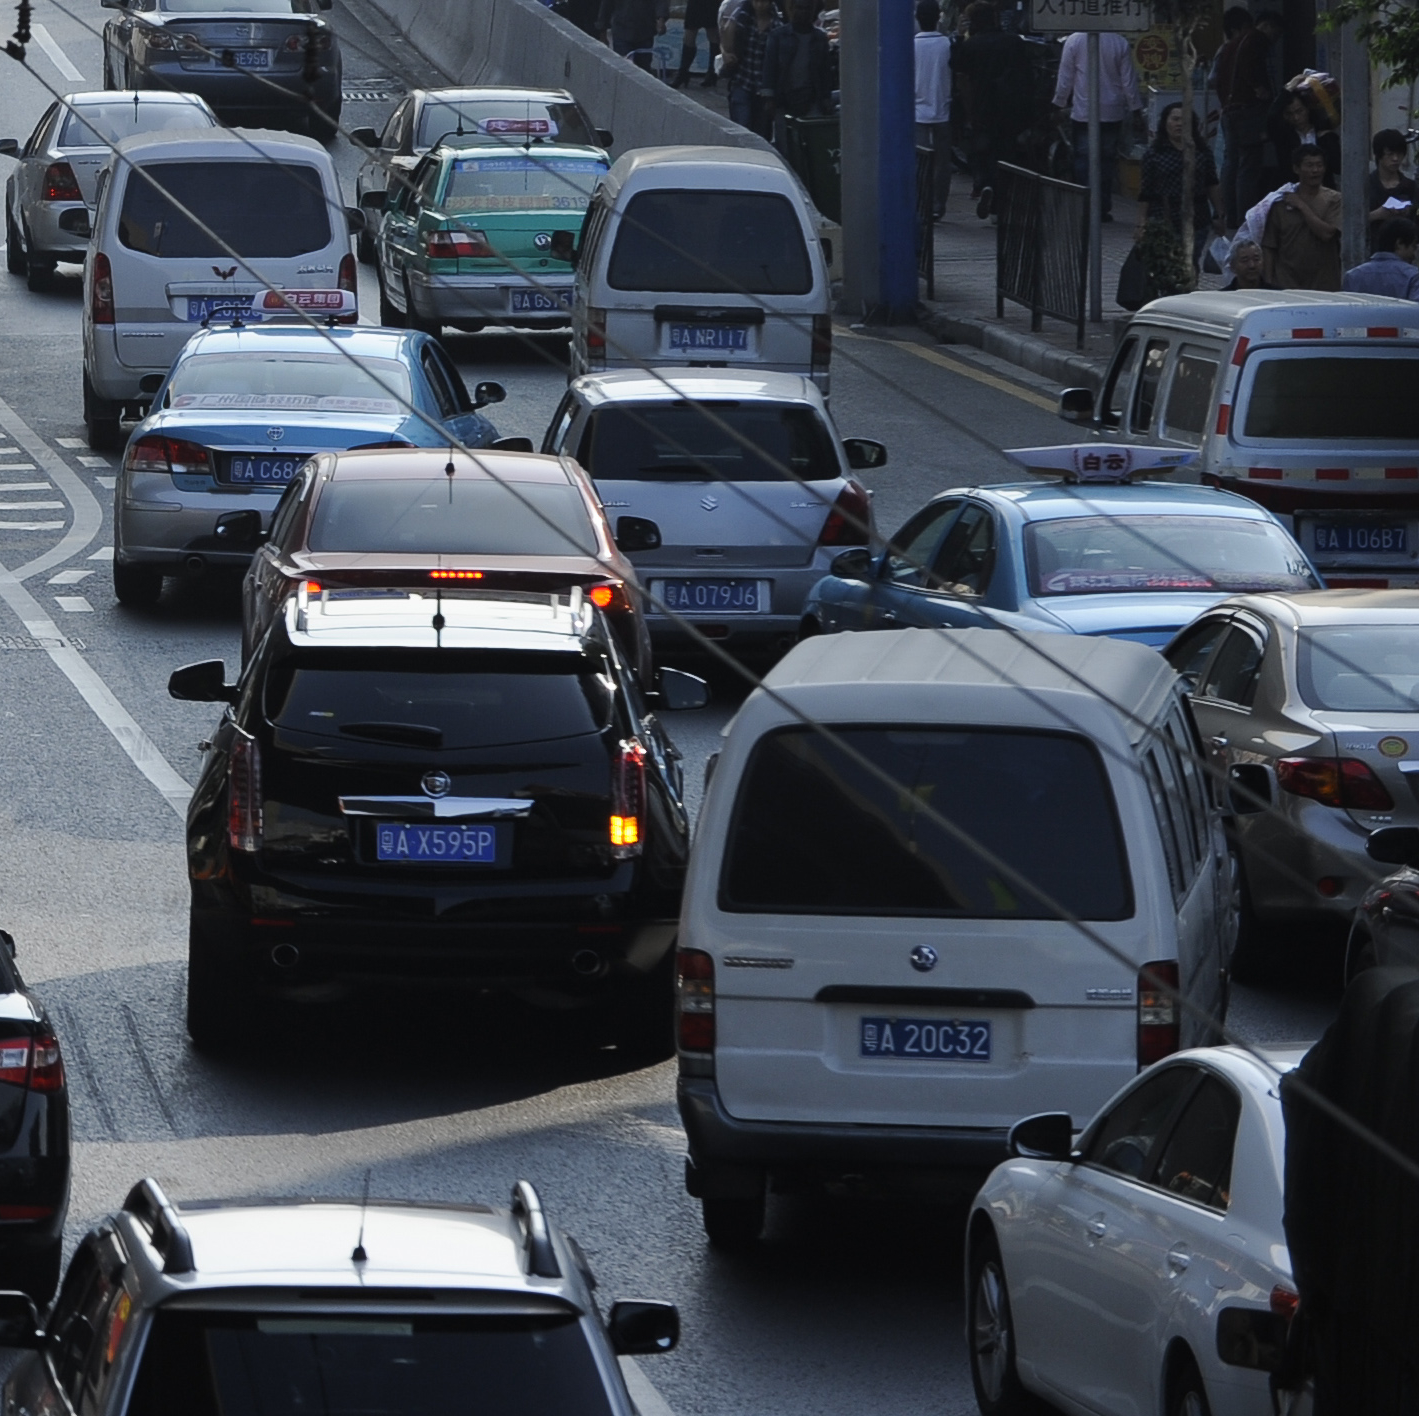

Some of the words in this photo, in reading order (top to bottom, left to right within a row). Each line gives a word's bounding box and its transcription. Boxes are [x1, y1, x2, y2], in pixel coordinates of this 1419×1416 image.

[283, 293, 341, 304] 白云集团
[1082, 452, 1125, 472] 白云
[1348, 528, 1405, 549] 106B7
[695, 586, 756, 606] 079J6
[903, 1024, 988, 1055] 20C32
